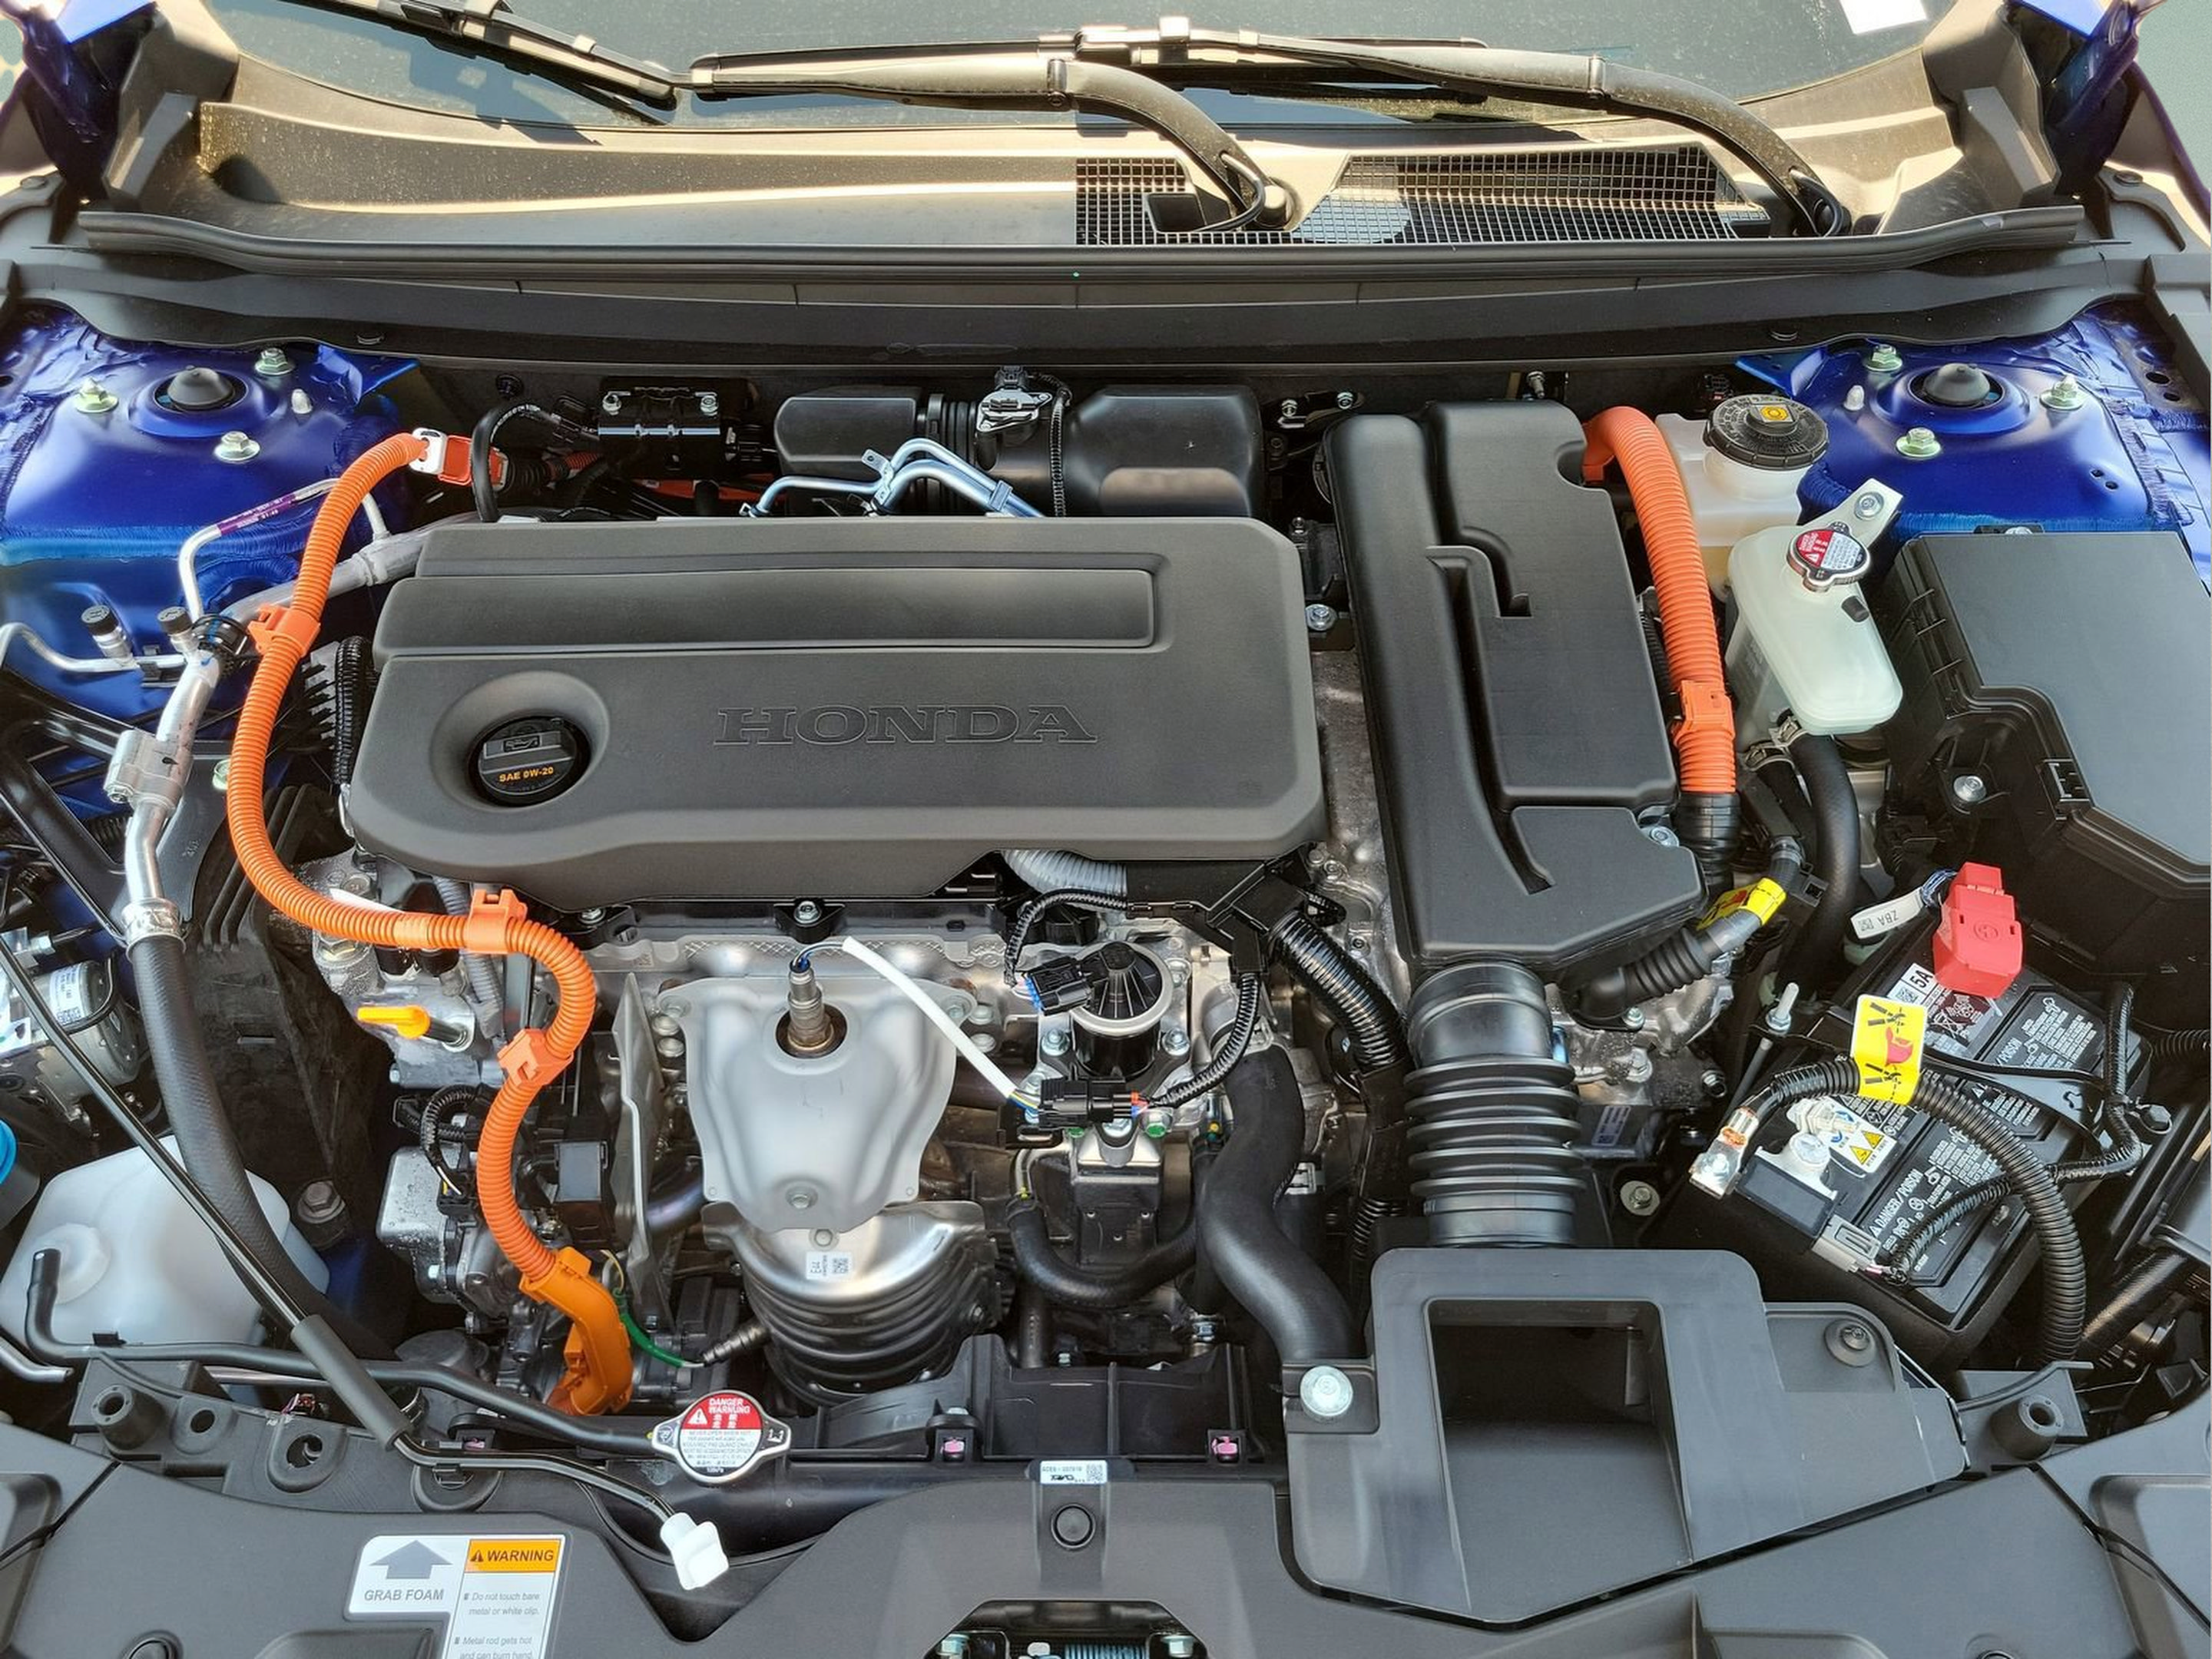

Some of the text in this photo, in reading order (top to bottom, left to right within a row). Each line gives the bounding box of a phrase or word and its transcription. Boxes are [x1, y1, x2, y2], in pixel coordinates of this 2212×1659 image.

[713, 704, 1098, 745] HONDA
[498, 771, 521, 783] SAE
[1910, 970, 1933, 988] 5A
[487, 1550, 554, 1562] WARNING
[364, 1589, 444, 1601] GRAB FOAM
[472, 1592, 483, 1601] Do
[499, 1592, 520, 1601] touch
[522, 1592, 540, 1601] bare
[469, 1607, 490, 1615] metal
[502, 1607, 522, 1615] white
[462, 1637, 532, 1647] Metal rod gets hot
